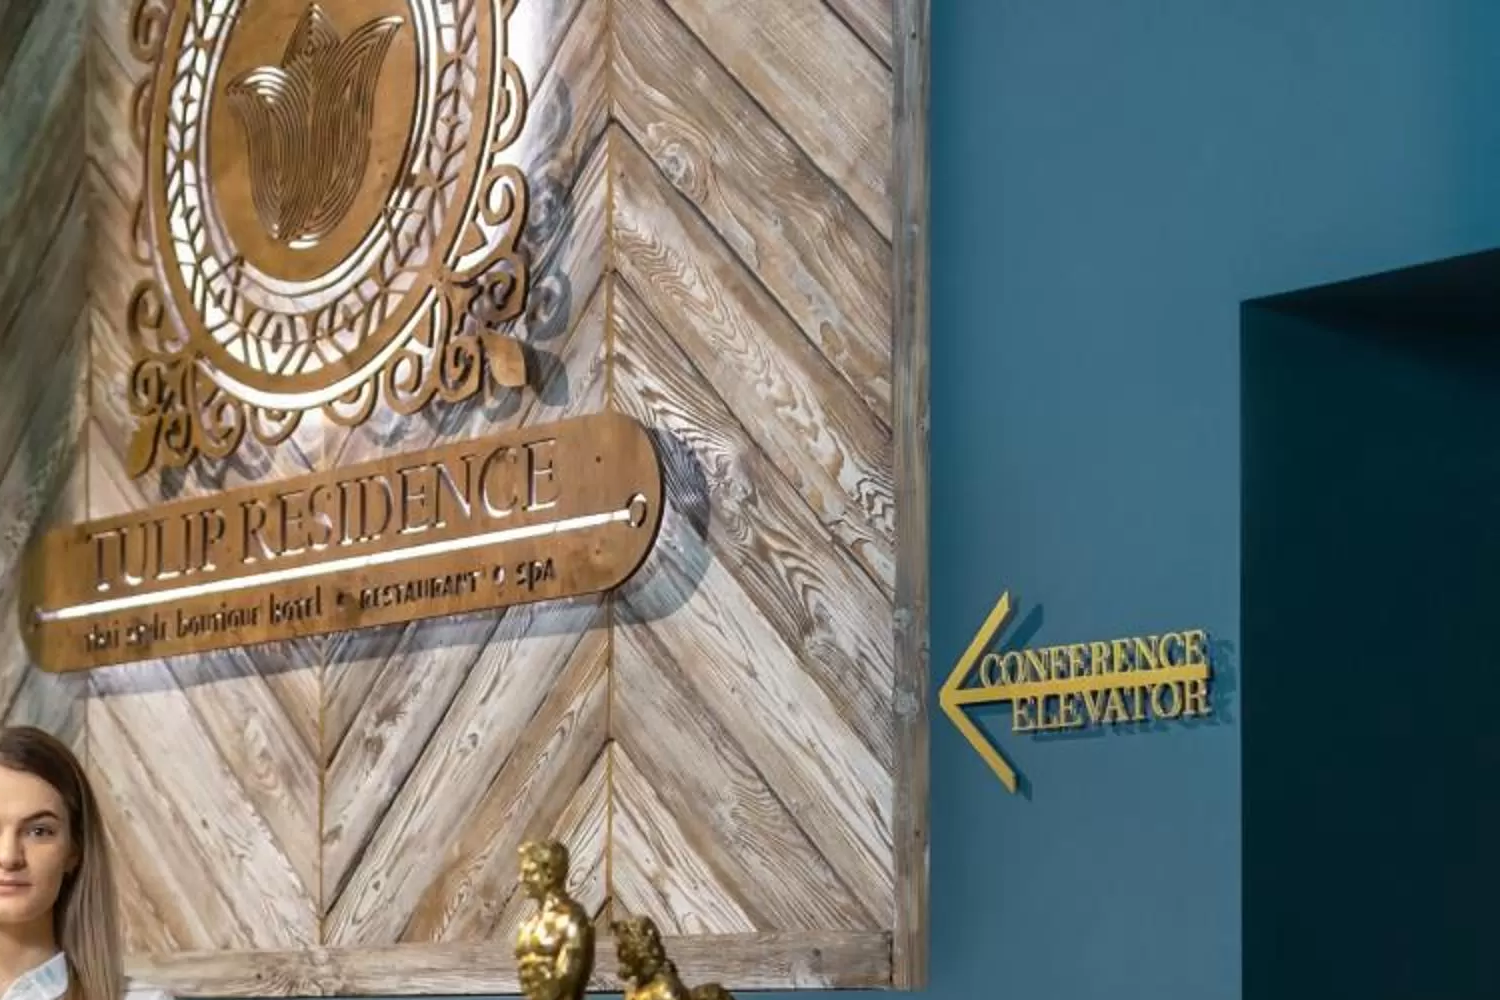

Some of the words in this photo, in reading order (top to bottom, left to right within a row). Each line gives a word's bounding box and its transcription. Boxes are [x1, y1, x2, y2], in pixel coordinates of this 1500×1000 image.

[84, 507, 226, 593] TULIP
[238, 436, 560, 566] RESIDENCE
[358, 569, 487, 611] RESTAURANT
[979, 628, 1206, 690] CONFERENCE
[1011, 677, 1212, 733] ELEVATOR
